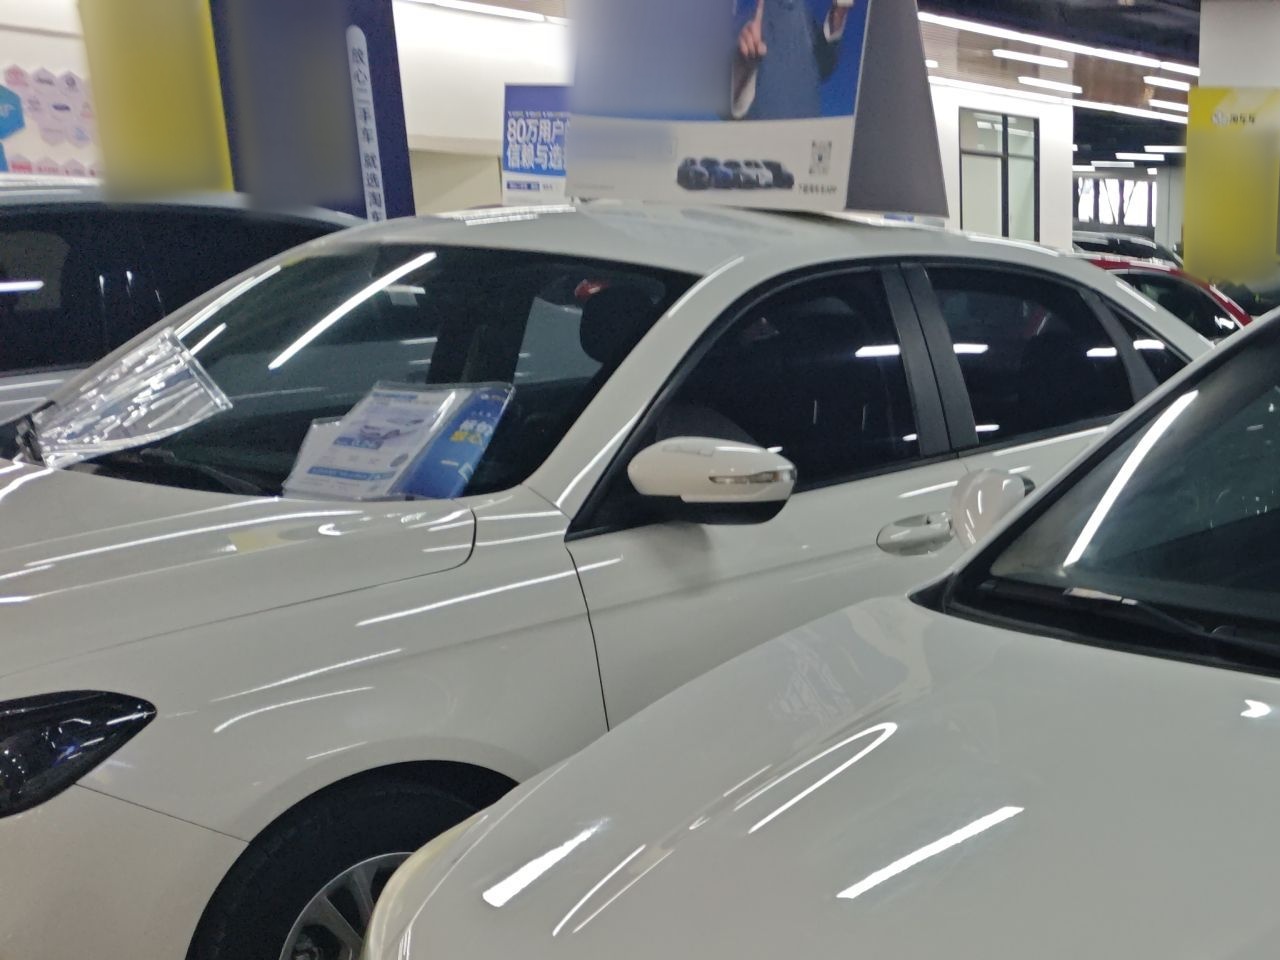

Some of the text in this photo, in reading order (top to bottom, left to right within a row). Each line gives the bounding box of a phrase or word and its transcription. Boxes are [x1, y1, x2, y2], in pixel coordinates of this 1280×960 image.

[506, 117, 568, 145] 80万用户
[506, 142, 566, 171] 信赖与选
